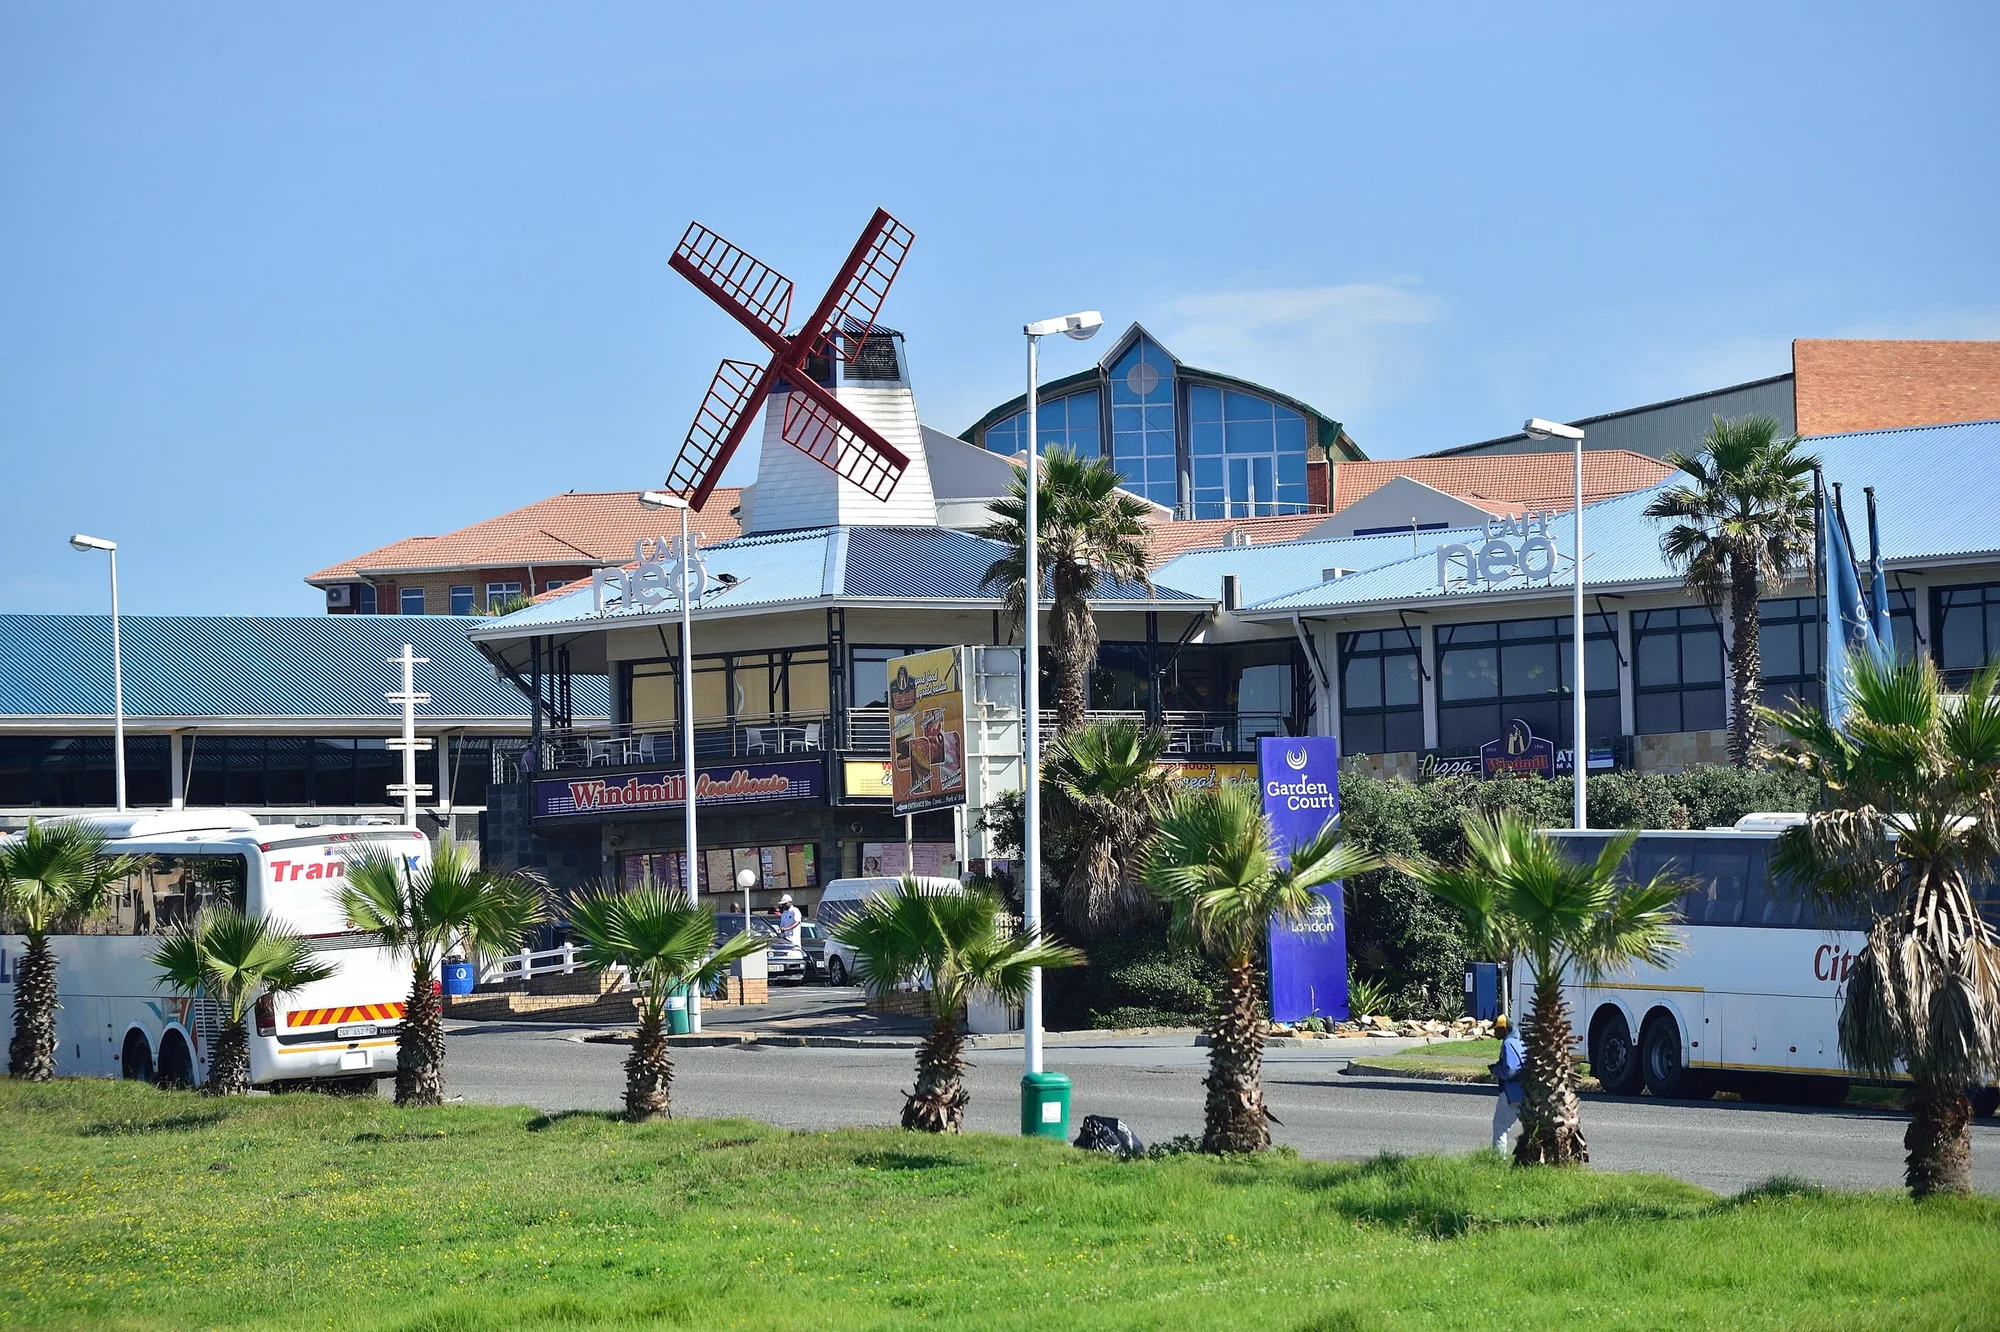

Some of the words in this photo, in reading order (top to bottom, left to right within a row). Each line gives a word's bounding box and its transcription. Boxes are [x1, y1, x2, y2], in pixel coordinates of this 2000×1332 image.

[1437, 537, 1557, 587] neo
[592, 558, 707, 611] neo
[1421, 753, 1473, 780] Pizza
[1485, 754, 1549, 772] Windmill
[1556, 750, 1574, 763] AT
[569, 774, 687, 811] Windmill
[695, 769, 789, 800] Roadhouse
[1267, 774, 1329, 797] Garden
[1287, 793, 1335, 811] Court
[1291, 919, 1335, 933] London
[1814, 944, 1859, 983] Cit
